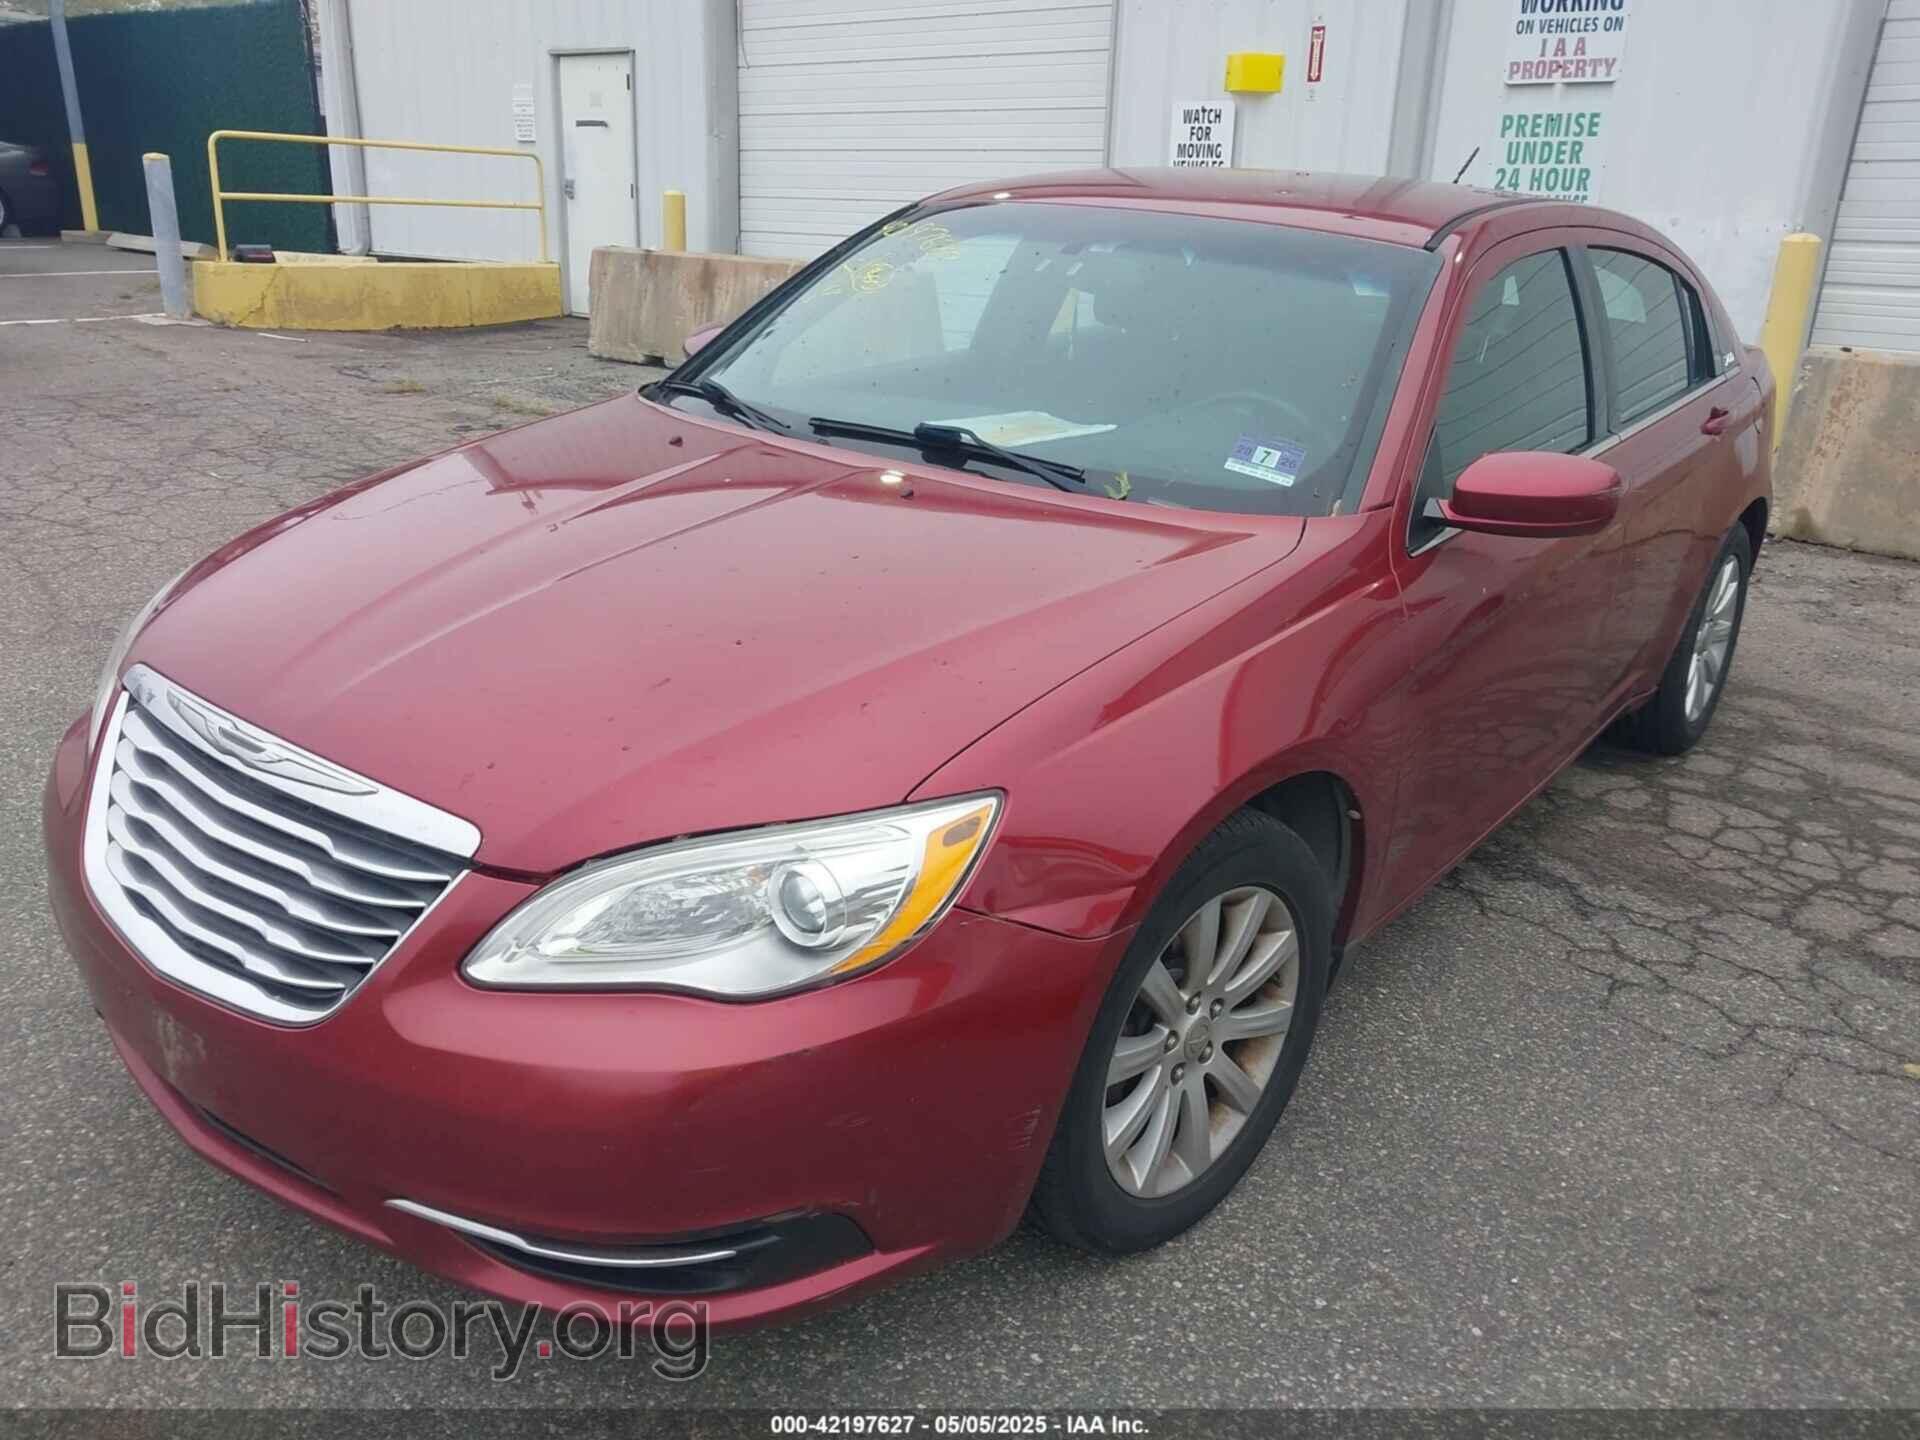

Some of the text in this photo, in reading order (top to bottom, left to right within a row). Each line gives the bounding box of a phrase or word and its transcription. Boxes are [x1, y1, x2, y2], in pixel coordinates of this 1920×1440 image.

[1516, 16, 1624, 35] ON VEHICLES ON
[1509, 57, 1617, 80] PROPERTY
[1183, 107, 1222, 124] WATCH
[1500, 112, 1601, 138] PREMISE
[1189, 126, 1212, 141] FOR
[1176, 143, 1222, 158] MOVING
[1506, 140, 1584, 165] UNDER
[1494, 167, 1591, 191] 24 HOUR
[1260, 450, 1272, 464] 7
